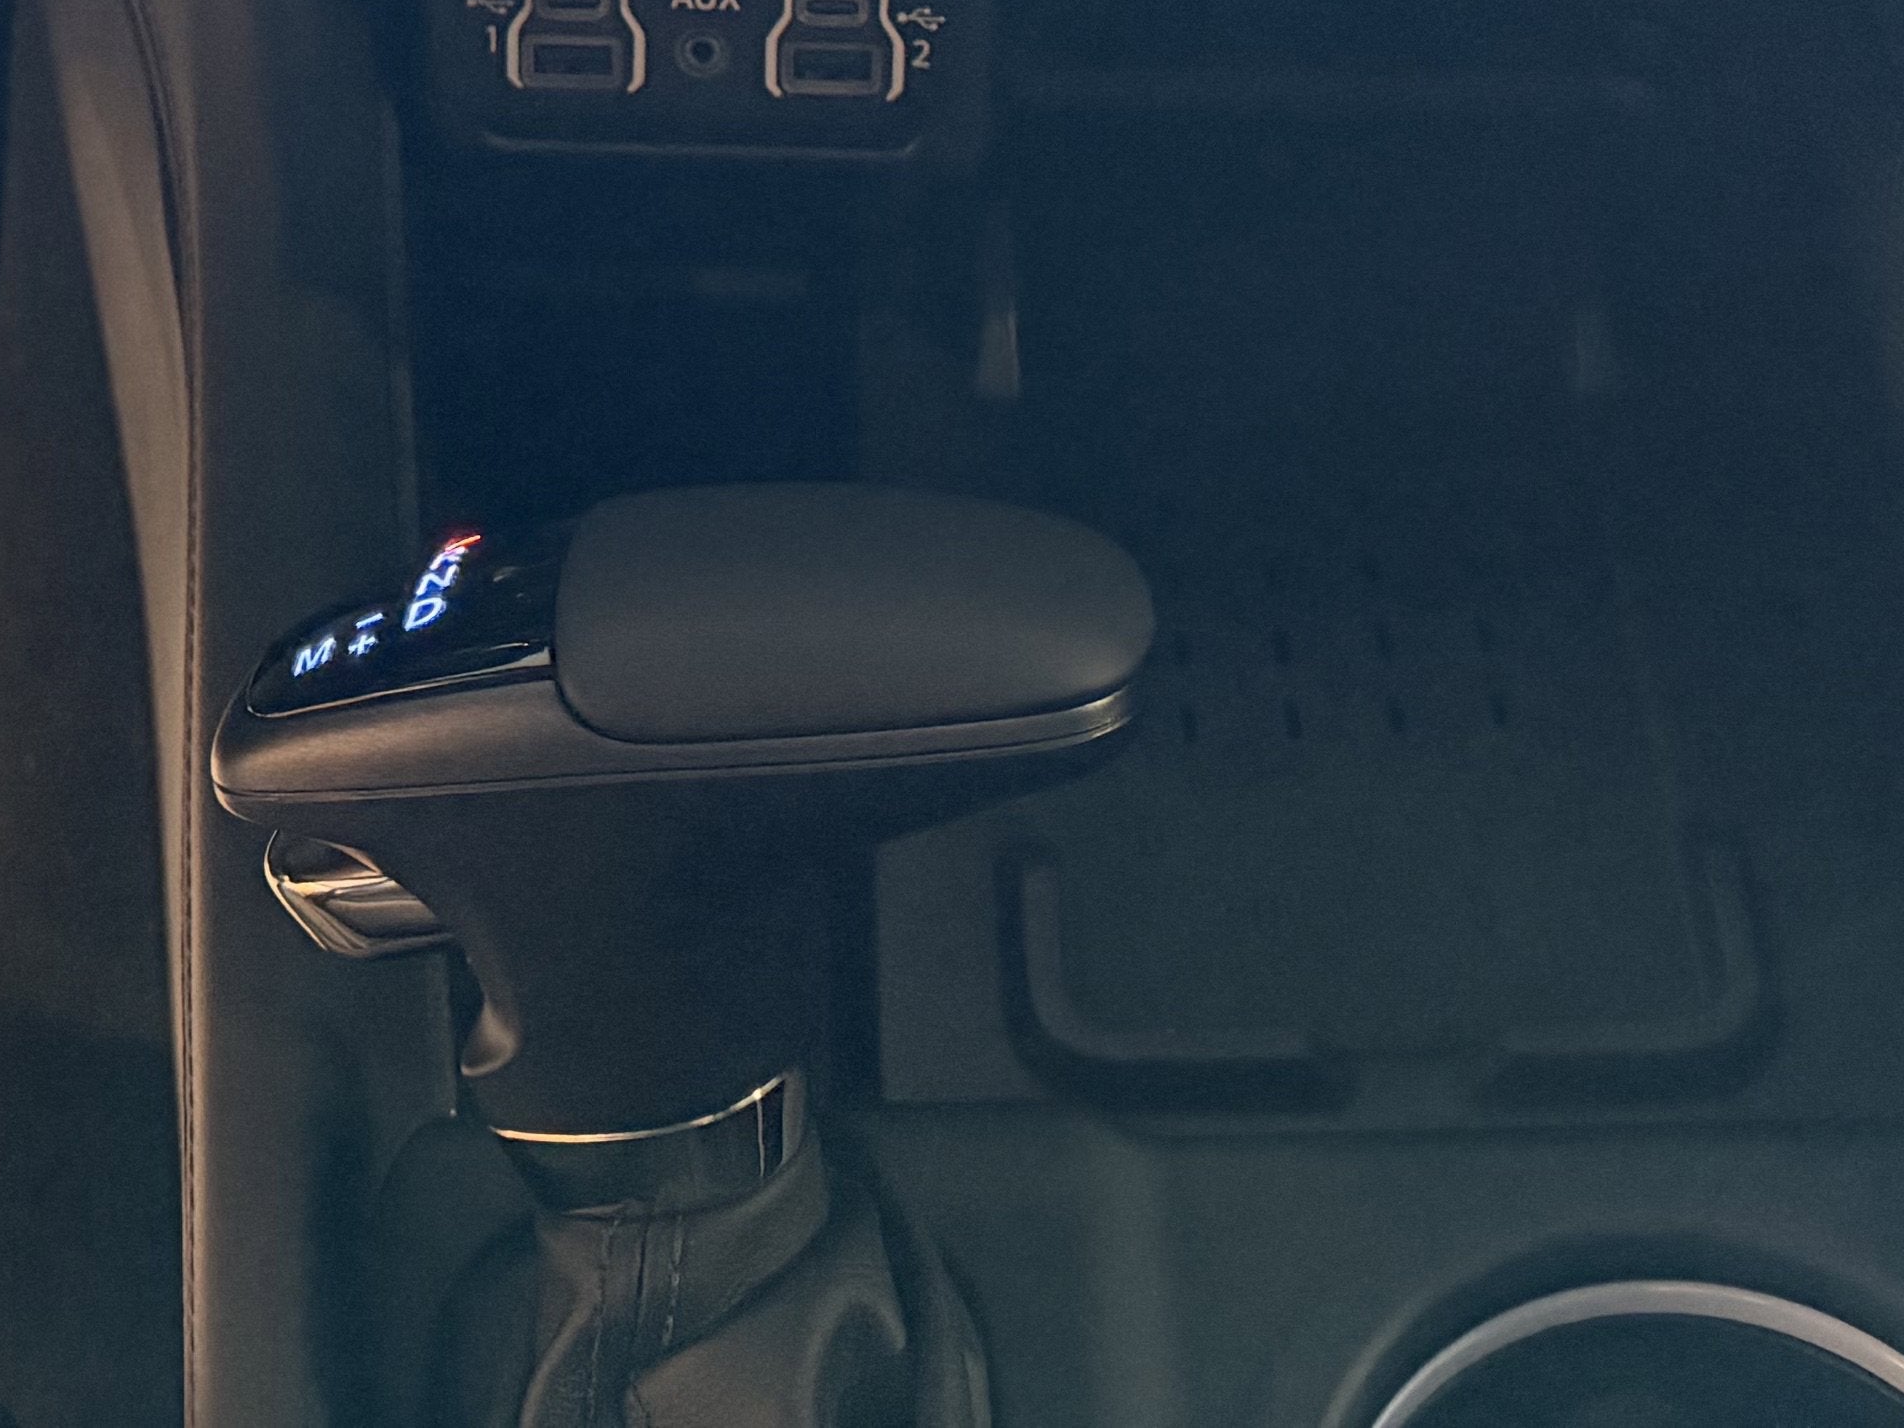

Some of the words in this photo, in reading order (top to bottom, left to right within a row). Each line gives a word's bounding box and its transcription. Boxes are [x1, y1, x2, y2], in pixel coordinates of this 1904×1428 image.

[486, 25, 498, 54] 1
[911, 38, 932, 70] 2
[291, 635, 338, 678] M
